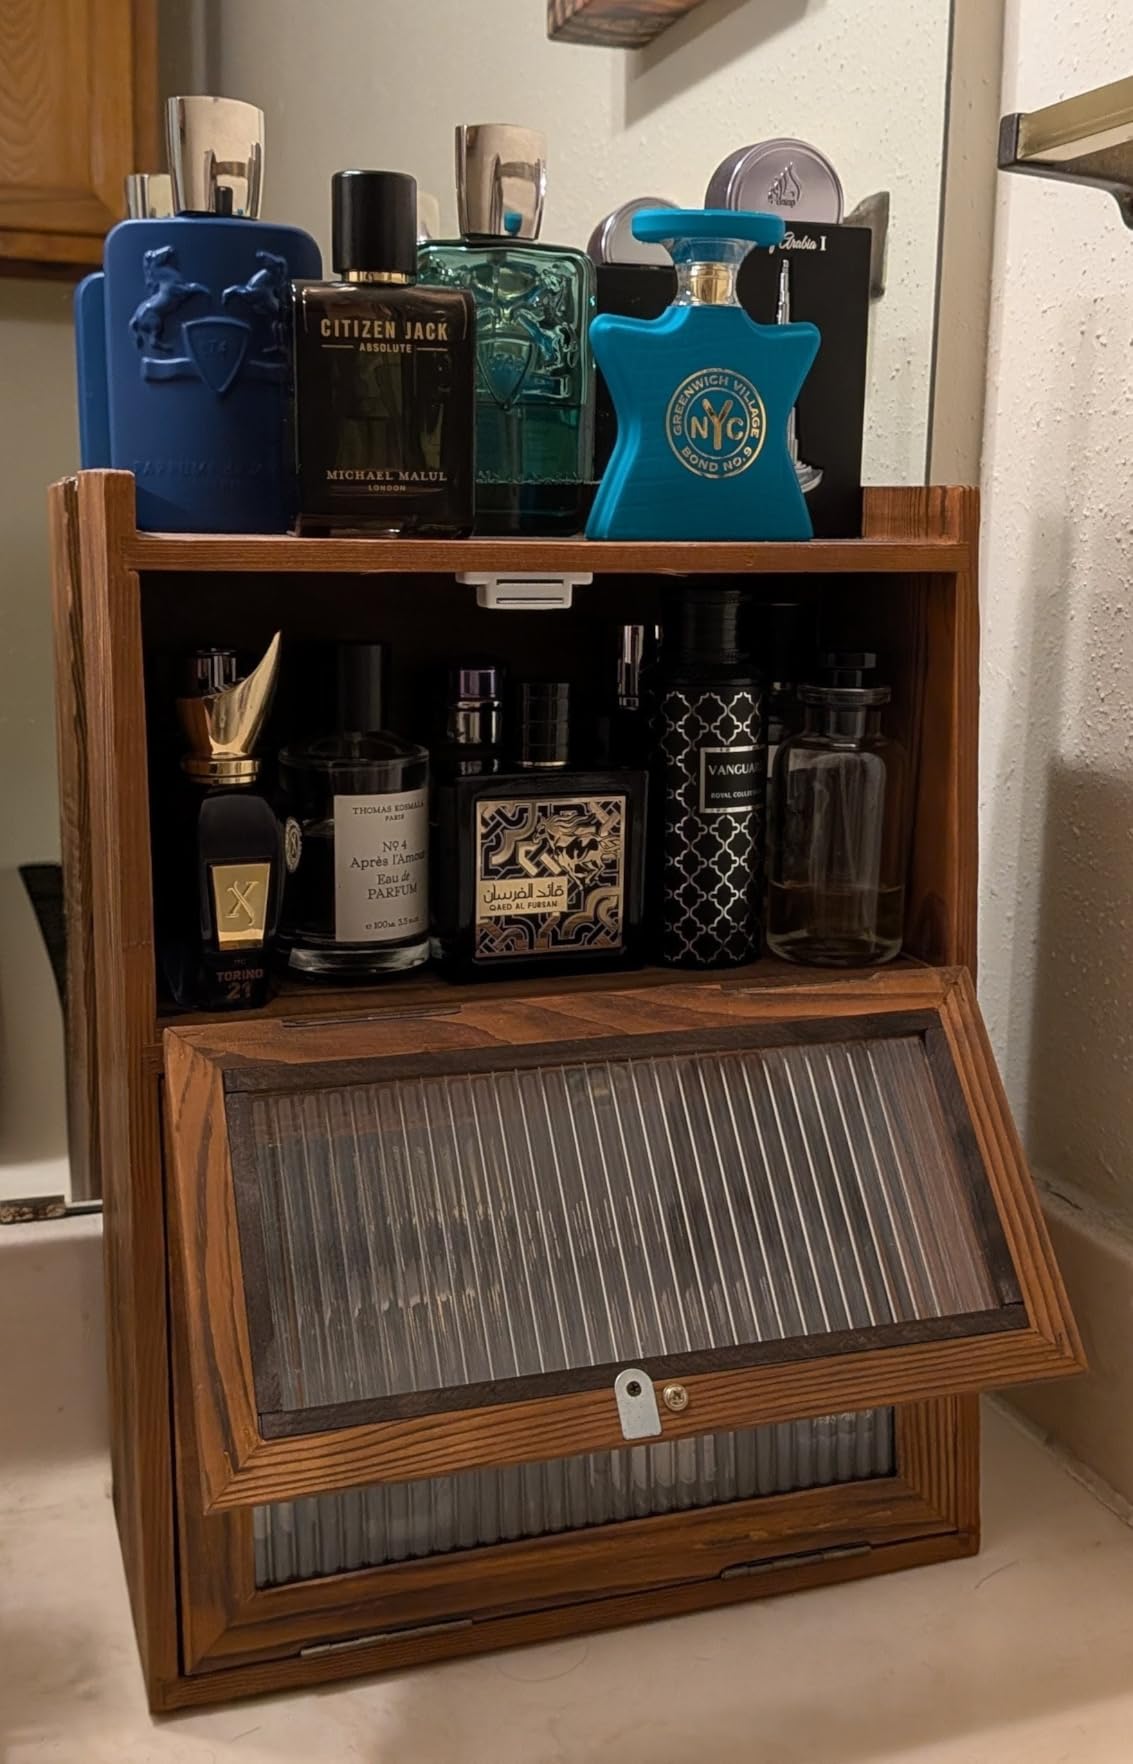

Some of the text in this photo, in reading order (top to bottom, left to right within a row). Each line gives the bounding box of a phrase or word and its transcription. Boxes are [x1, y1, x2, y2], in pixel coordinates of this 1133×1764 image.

[819, 236, 827, 251] I
[320, 319, 448, 340] CITIZEN JACK
[359, 342, 412, 353] ABSOLUTE
[673, 375, 760, 438] GREENWICH VILLAGE
[690, 398, 744, 450] NYC
[681, 446, 719, 472] BOND
[326, 470, 448, 481] MICHAEL MALUL
[368, 484, 406, 492] LONDON
[352, 805, 392, 815] THOMAS
[349, 856, 388, 870] Après
[376, 873, 398, 885] Eau
[367, 882, 417, 899] PARFUM
[482, 882, 564, 904] قائد الفرسان
[489, 900, 558, 912] QAED AL FURSAN
[216, 968, 264, 984] TORINO
[226, 981, 252, 1000] 21
